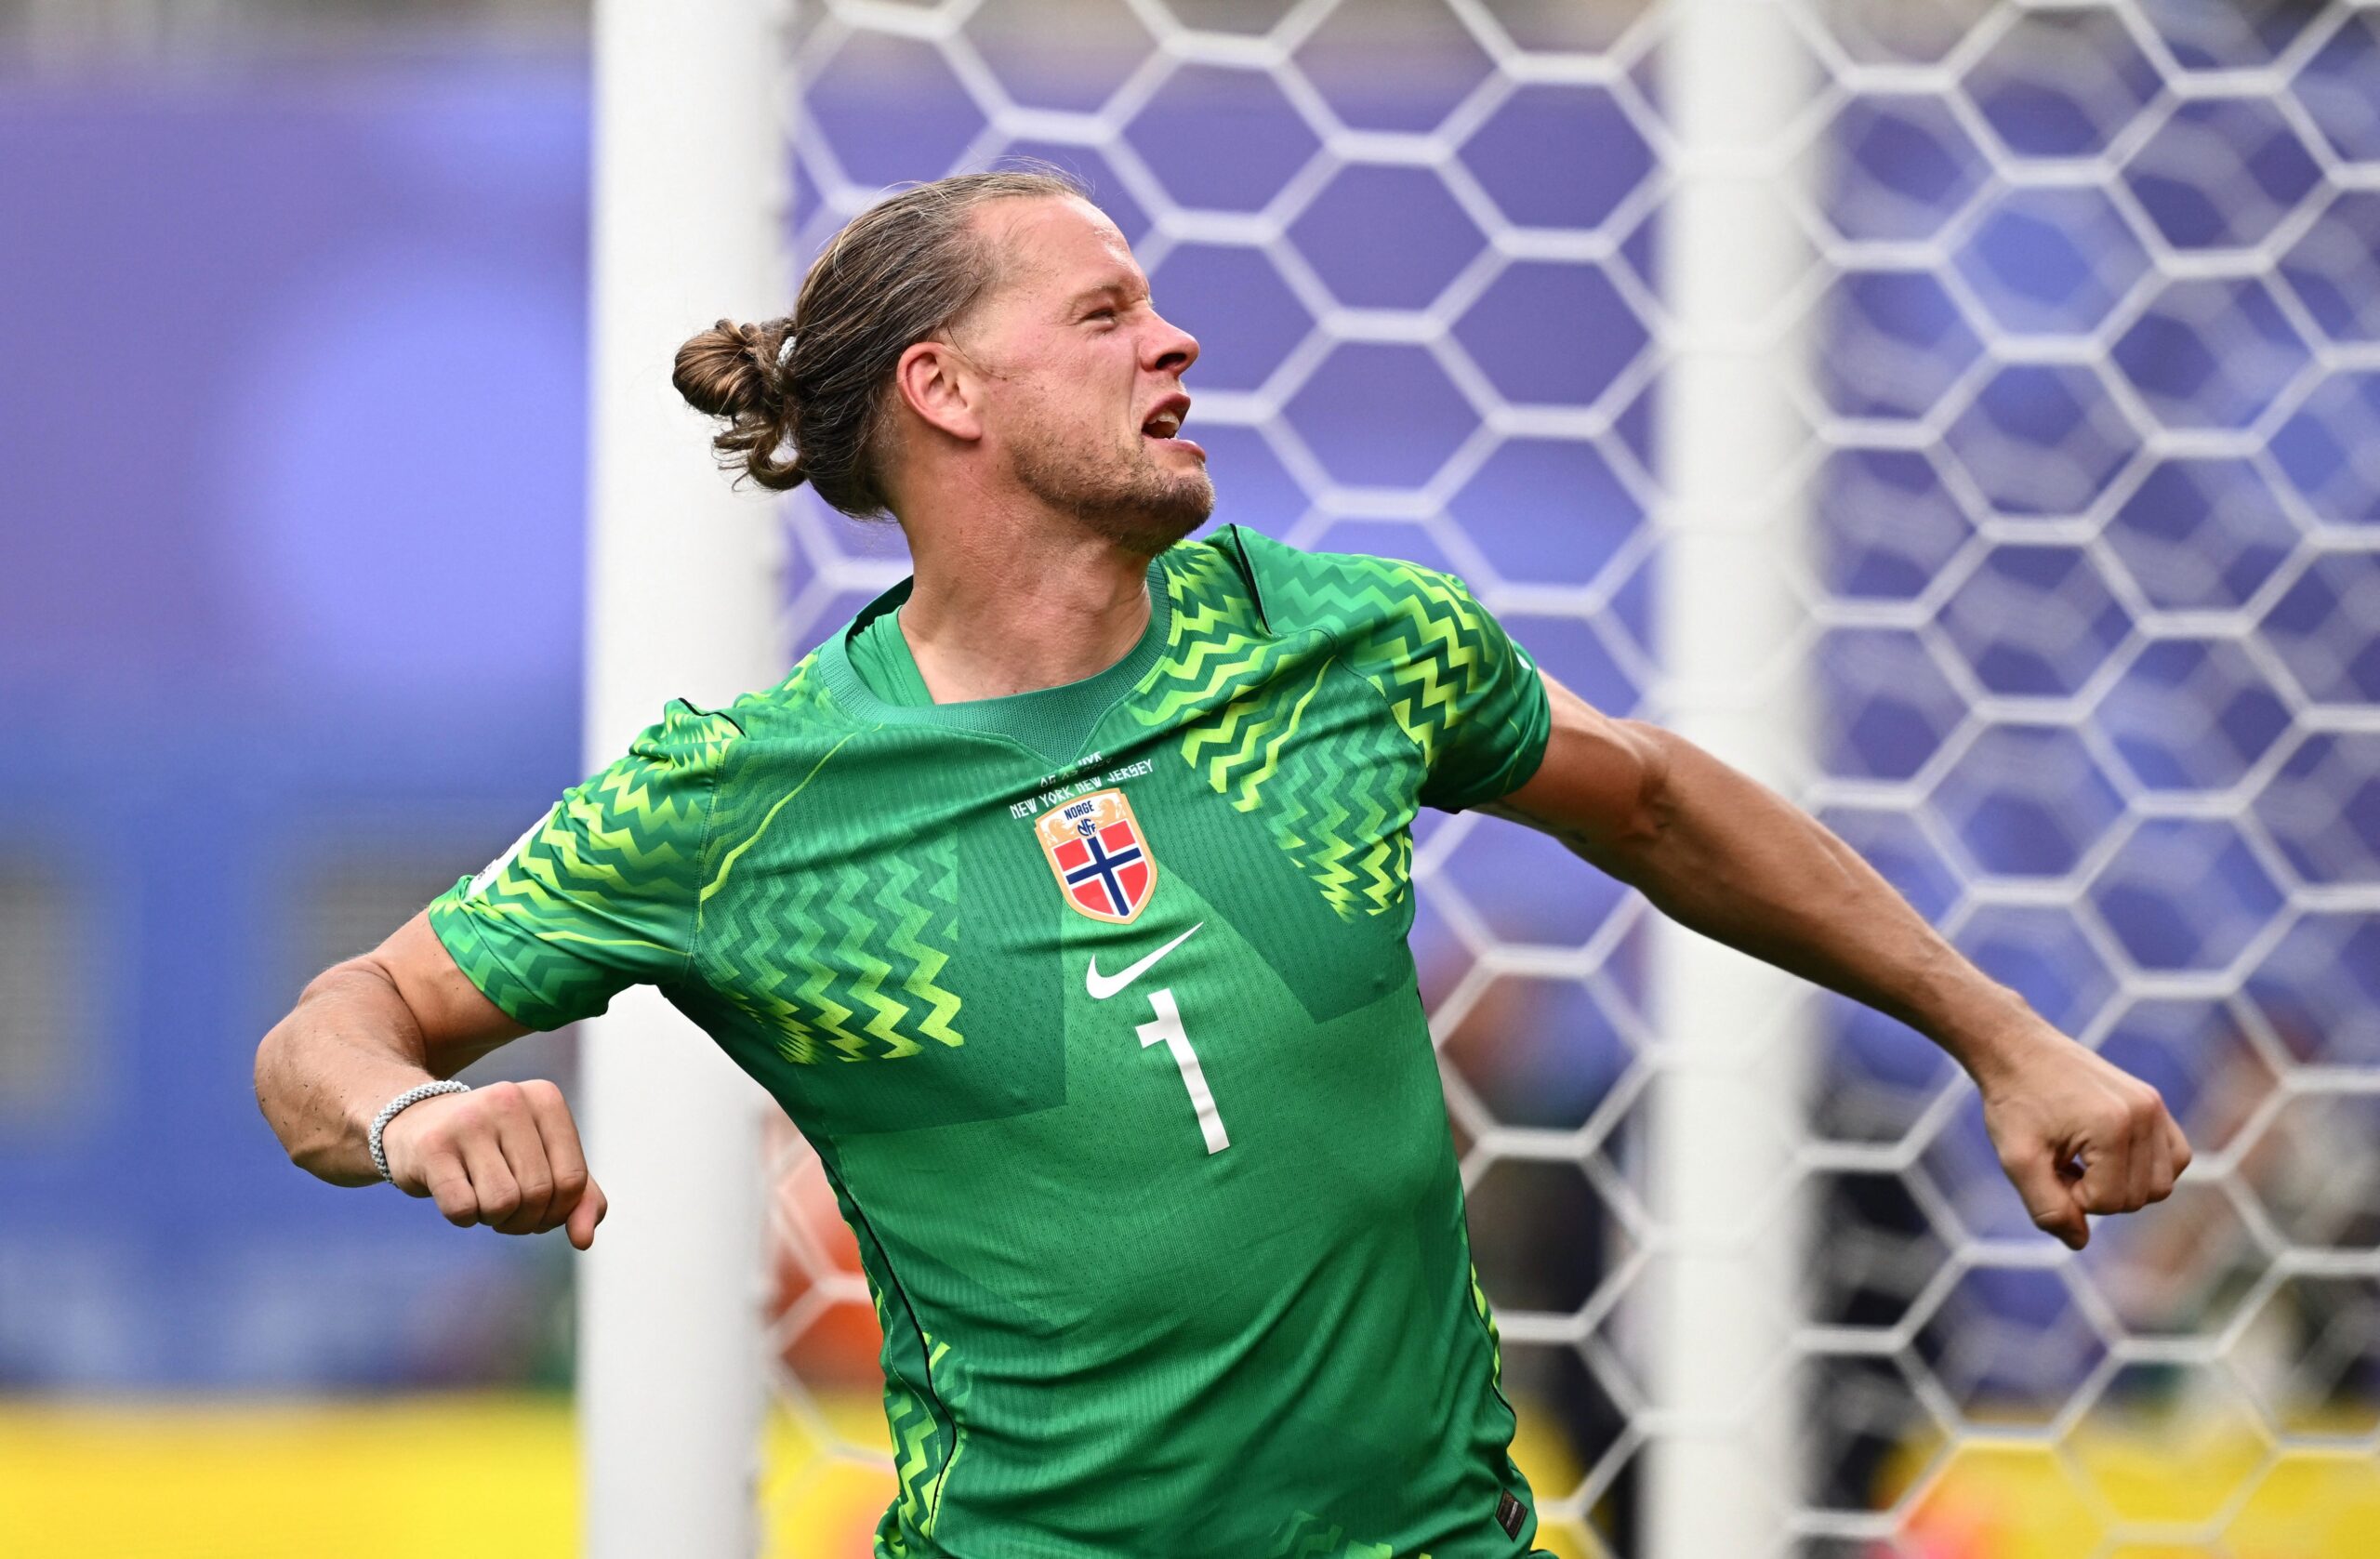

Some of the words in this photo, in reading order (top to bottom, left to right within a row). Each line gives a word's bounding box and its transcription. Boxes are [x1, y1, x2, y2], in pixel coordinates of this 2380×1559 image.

[1009, 798, 1038, 820] NEW
[1038, 786, 1076, 809] YORK
[1075, 776, 1103, 794] NEW
[1106, 759, 1155, 783] JERSEY
[1064, 800, 1094, 821] NORGE
[1135, 987, 1230, 1155] 1
